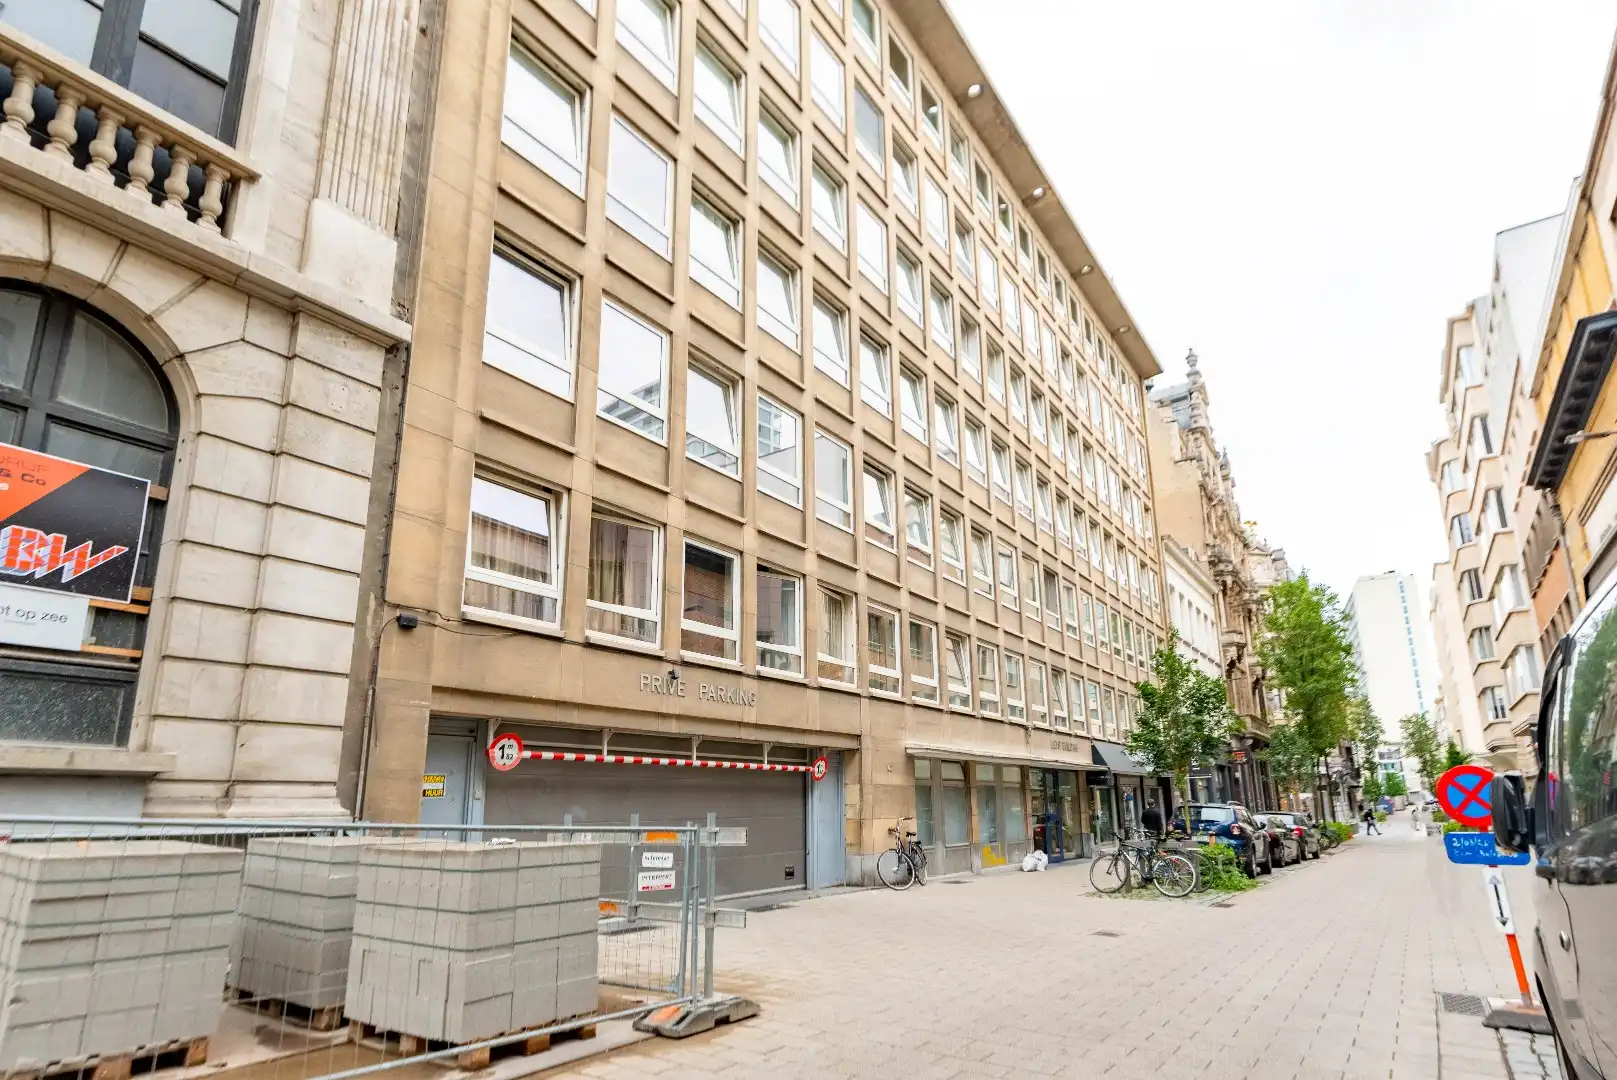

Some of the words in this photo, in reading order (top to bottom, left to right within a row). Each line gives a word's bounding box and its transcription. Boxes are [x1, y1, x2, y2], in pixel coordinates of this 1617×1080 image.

[21, 473, 46, 486] Co
[15, 608, 36, 621] op
[40, 612, 68, 624] zee
[699, 683, 757, 708] PARKING
